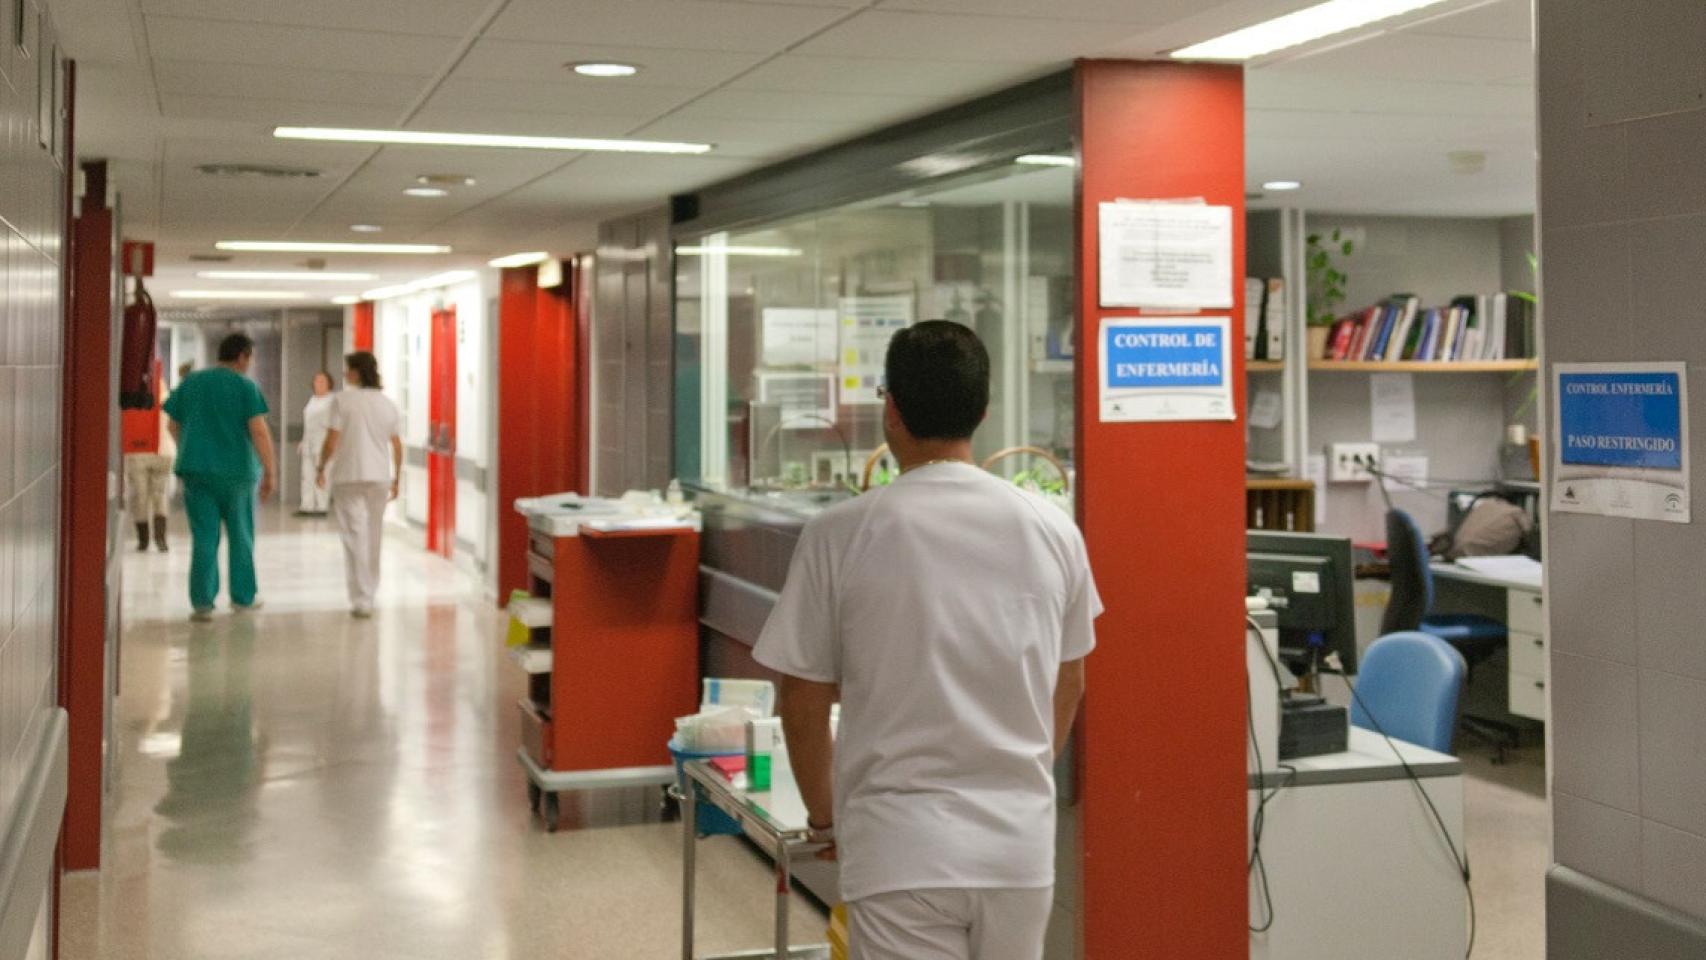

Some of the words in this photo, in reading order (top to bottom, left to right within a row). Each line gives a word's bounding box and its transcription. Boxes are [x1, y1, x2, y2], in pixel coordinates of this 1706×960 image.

[1114, 333, 1191, 348] CONTROL
[1195, 333, 1216, 347] DE
[1116, 359, 1219, 378] ENFERMERÍA
[1567, 383, 1608, 394] CONTROL
[1611, 380, 1673, 395] ENFERMERÍA
[1568, 435, 1595, 449] PASO
[1598, 436, 1675, 452] RESTRINGIDO
